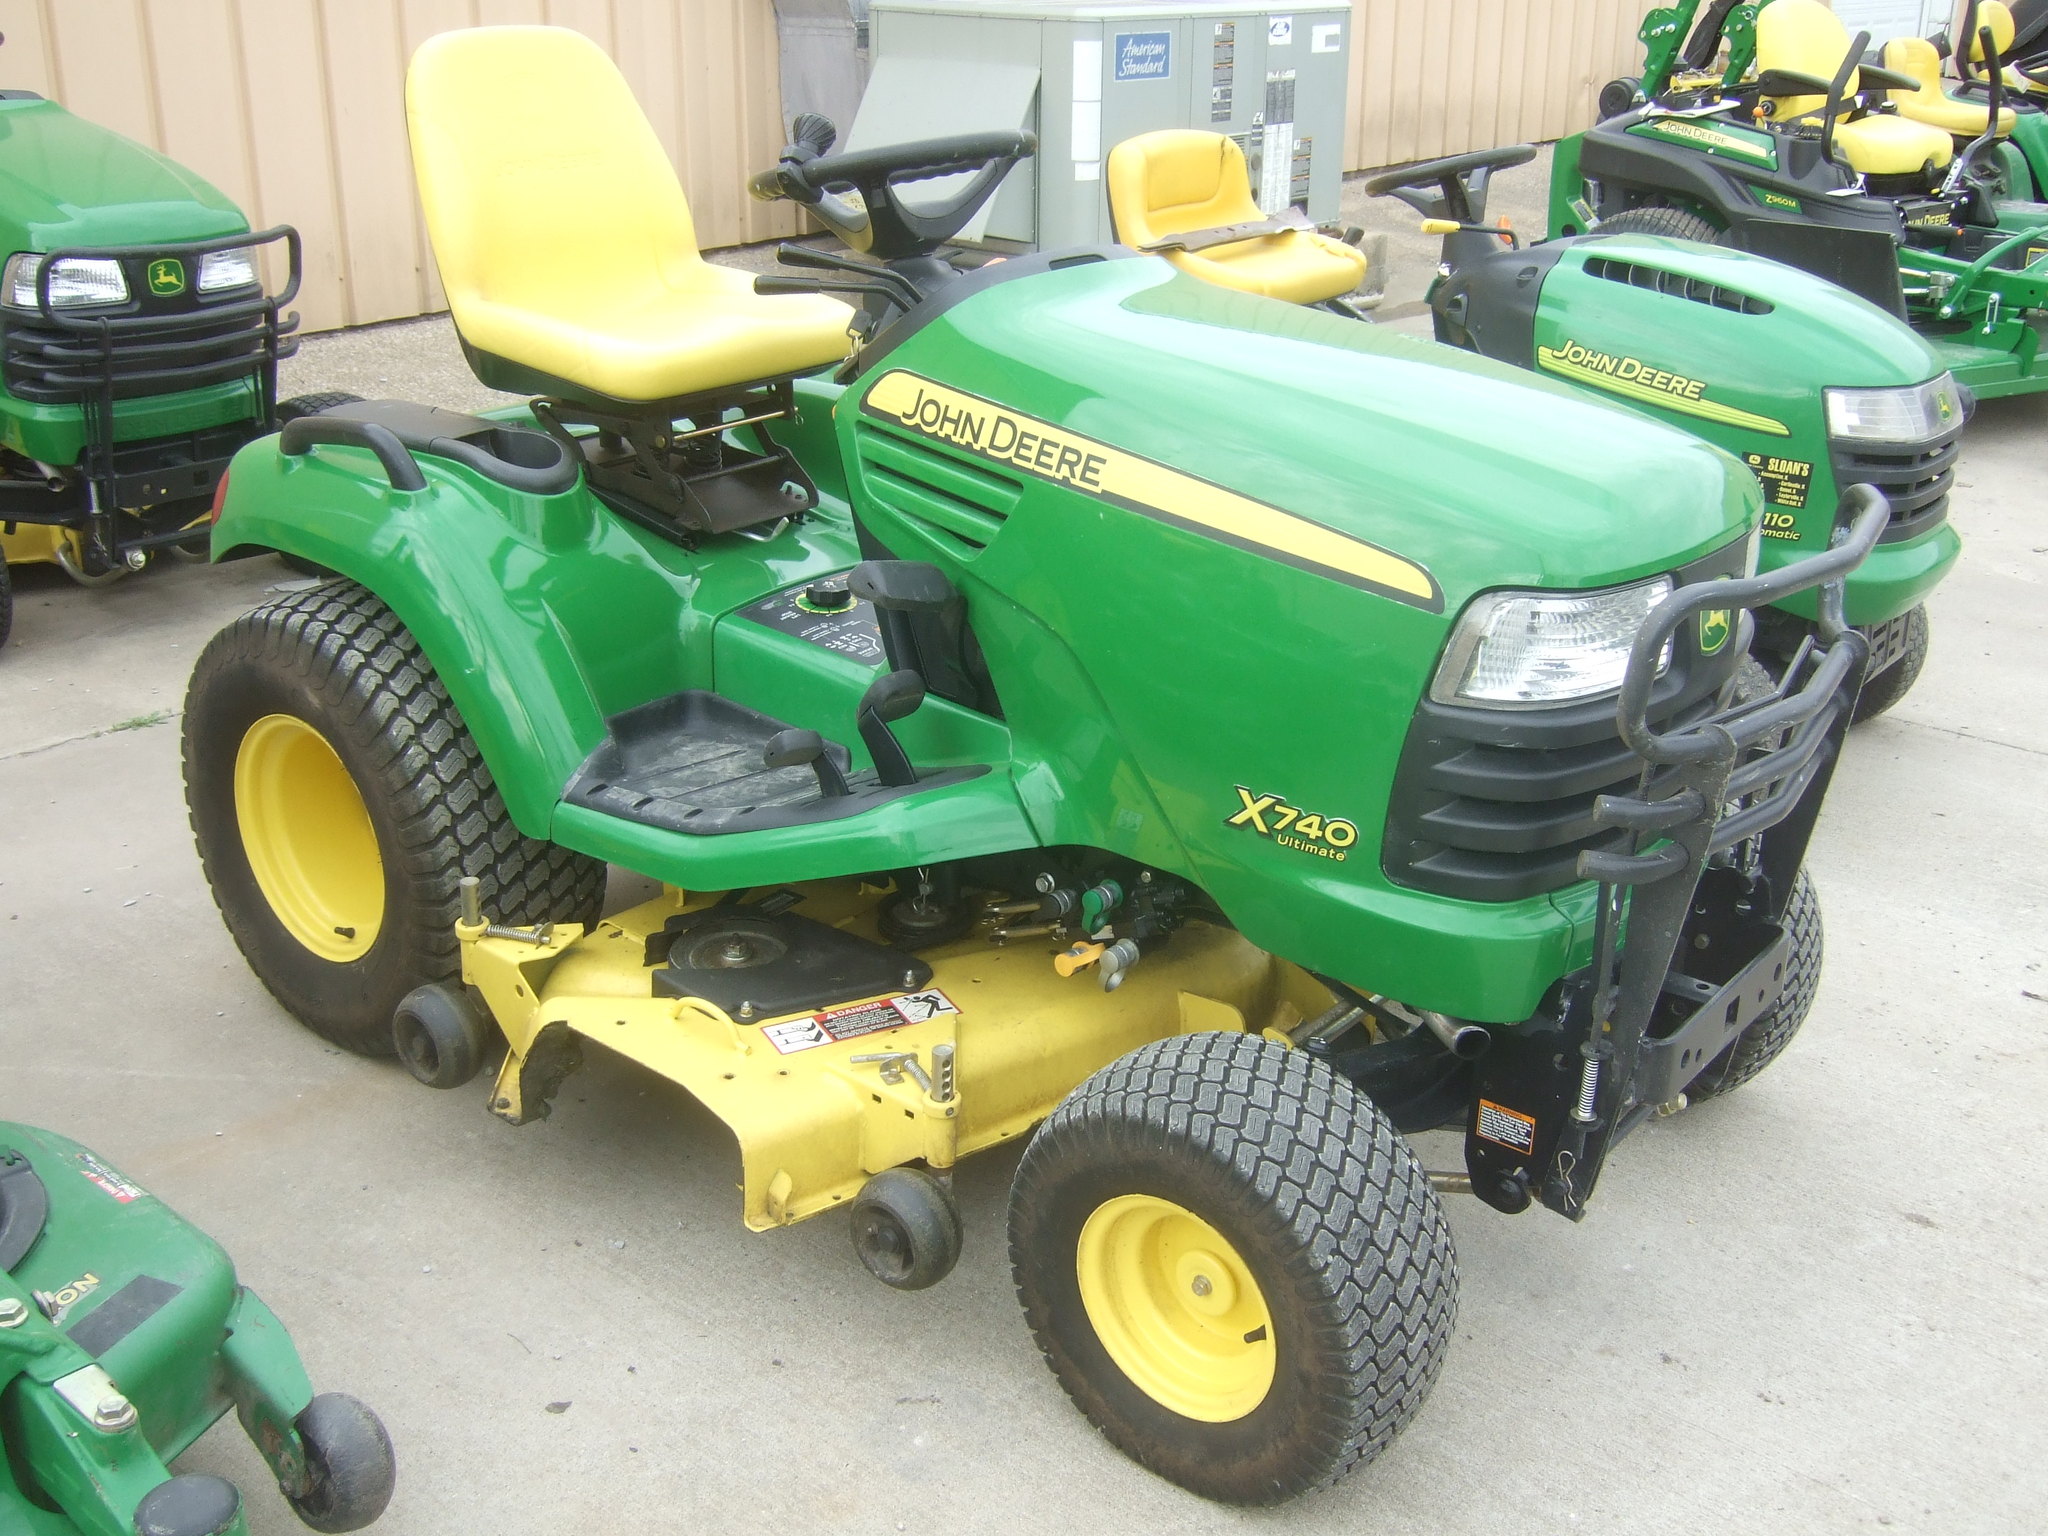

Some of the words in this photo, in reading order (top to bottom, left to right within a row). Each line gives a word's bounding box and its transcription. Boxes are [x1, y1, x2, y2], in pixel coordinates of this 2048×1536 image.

[1121, 37, 1165, 58] American
[1118, 55, 1166, 77] Standard
[1663, 121, 1692, 136] JOHN
[1693, 127, 1728, 145] DEERE
[1551, 339, 1619, 375] JOHN
[1615, 356, 1706, 400] DEERE
[901, 388, 986, 445] JOHN
[987, 415, 1108, 488] DEERE
[1767, 457, 1810, 477] SLOAN'S
[1223, 785, 1359, 850] X740
[1276, 833, 1347, 863] Ultimate
[836, 1002, 882, 1017] DANGER
